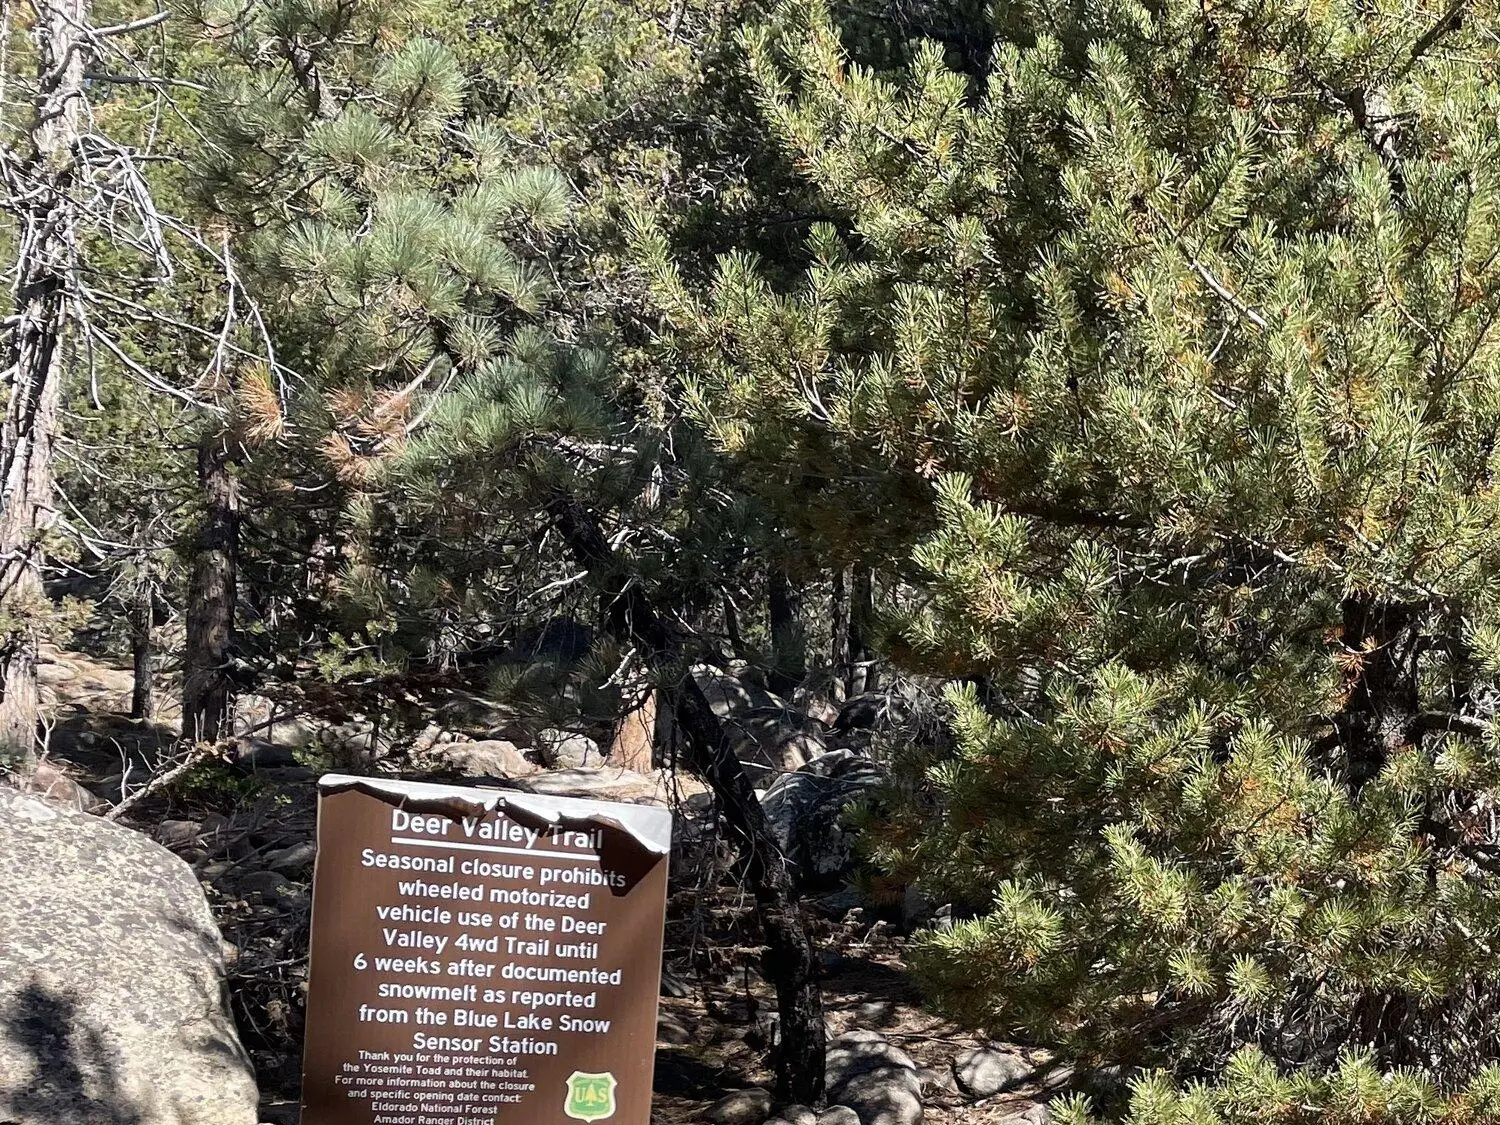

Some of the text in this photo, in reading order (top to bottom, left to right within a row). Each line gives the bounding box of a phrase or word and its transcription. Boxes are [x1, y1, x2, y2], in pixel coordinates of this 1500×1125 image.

[391, 809, 604, 849] Deer Valley Trail
[361, 849, 626, 887] Seasonal closure prohibits
[398, 879, 590, 909] wheeled motorized
[377, 904, 606, 934] vehicle use of the Deer
[383, 928, 598, 958] Valley 4wd Trail until
[353, 954, 622, 985] 6 weeks after documented
[378, 982, 596, 1009] snowmelt as reported
[359, 1005, 610, 1033] from the Blue Lake Snow
[413, 1033, 558, 1055] Sensor Station
[343, 1063, 360, 1073] the
[363, 1064, 412, 1074] Yosemite
[416, 1065, 441, 1075] Toad
[444, 1067, 462, 1076] and
[465, 1068, 488, 1077] their
[358, 1050, 517, 1066] Thank you for the protection of
[335, 1076, 535, 1091] For more information about the closure
[348, 1089, 368, 1098] and
[370, 1090, 410, 1101] specific
[413, 1092, 454, 1102] opening
[457, 1092, 479, 1101] date
[372, 1103, 497, 1114] Eldorado National Forest
[374, 1115, 415, 1125] Amador
[457, 1117, 494, 1125] District
